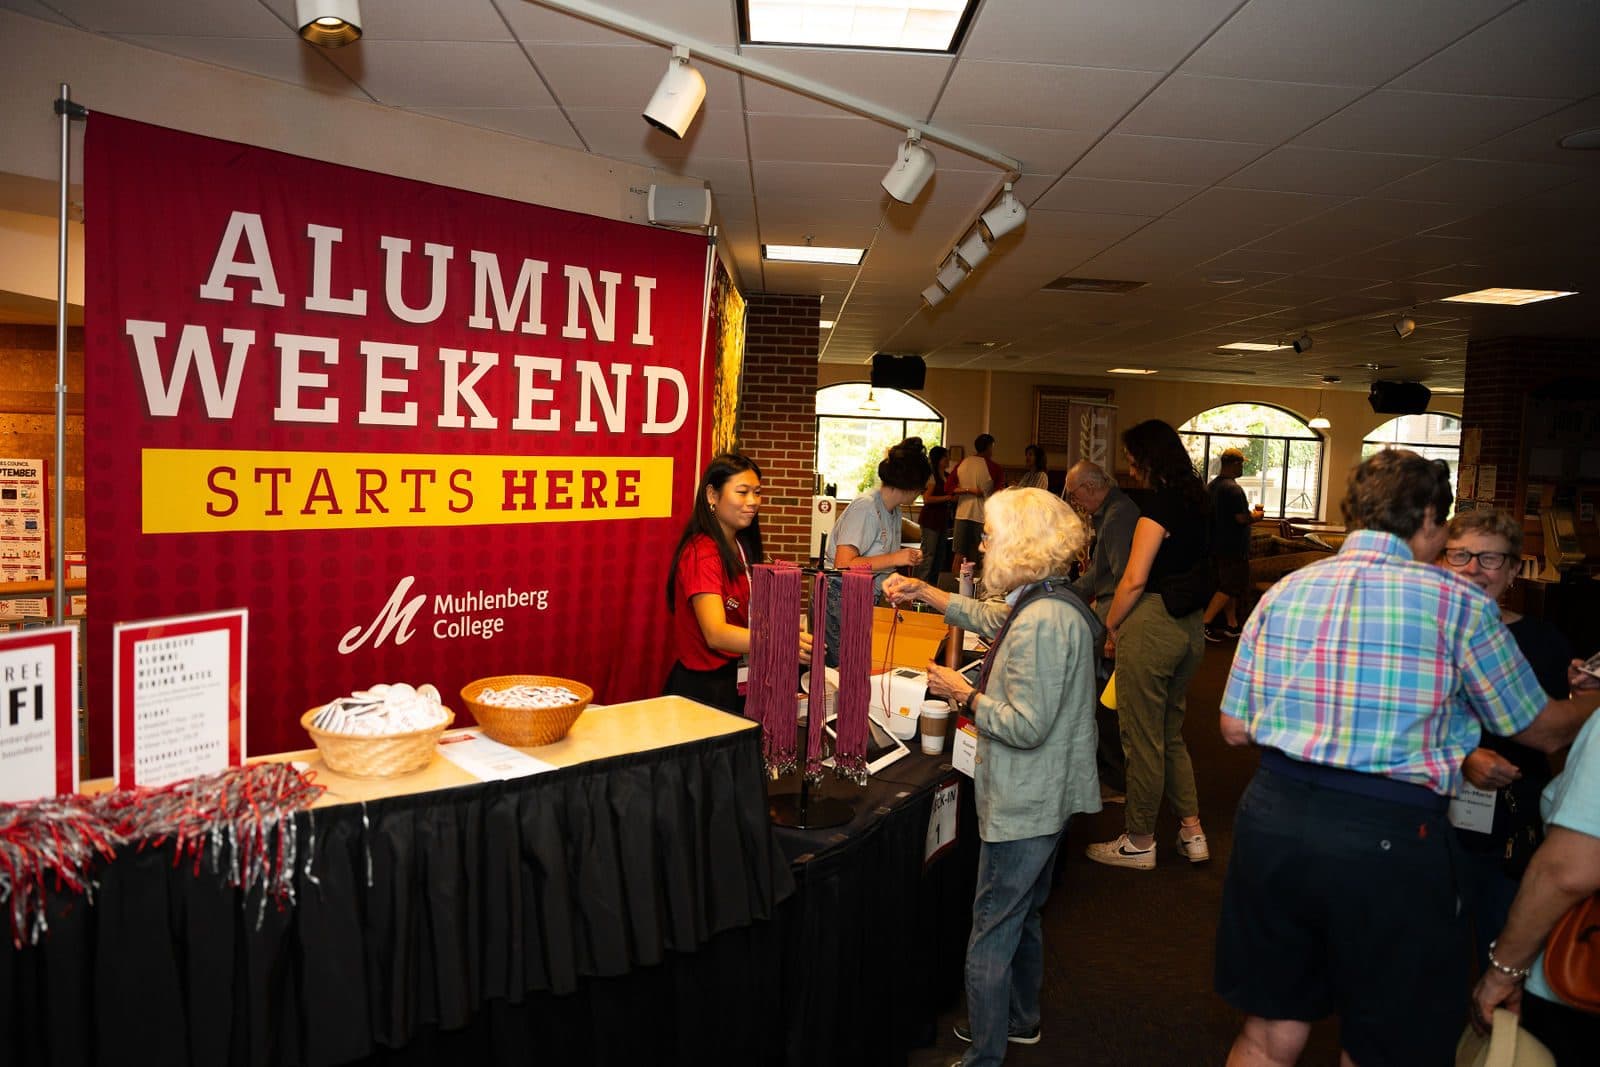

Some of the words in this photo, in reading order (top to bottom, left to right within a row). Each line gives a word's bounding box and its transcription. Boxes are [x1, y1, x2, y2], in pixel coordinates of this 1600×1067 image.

[201, 212, 657, 346] ALUMNI
[126, 320, 689, 434] WEEKEND
[206, 465, 474, 518] STARTS
[501, 469, 641, 511] HERE
[434, 587, 549, 615] Muhlenberg
[433, 615, 504, 640] College
[138, 653, 178, 665] ALUMNI
[138, 663, 185, 678] WEEKEND
[5, 661, 43, 683] REE
[138, 676, 175, 690] DINING
[0, 684, 43, 727] FI
[138, 707, 170, 720] FRIDAY
[935, 823, 941, 844] 1
